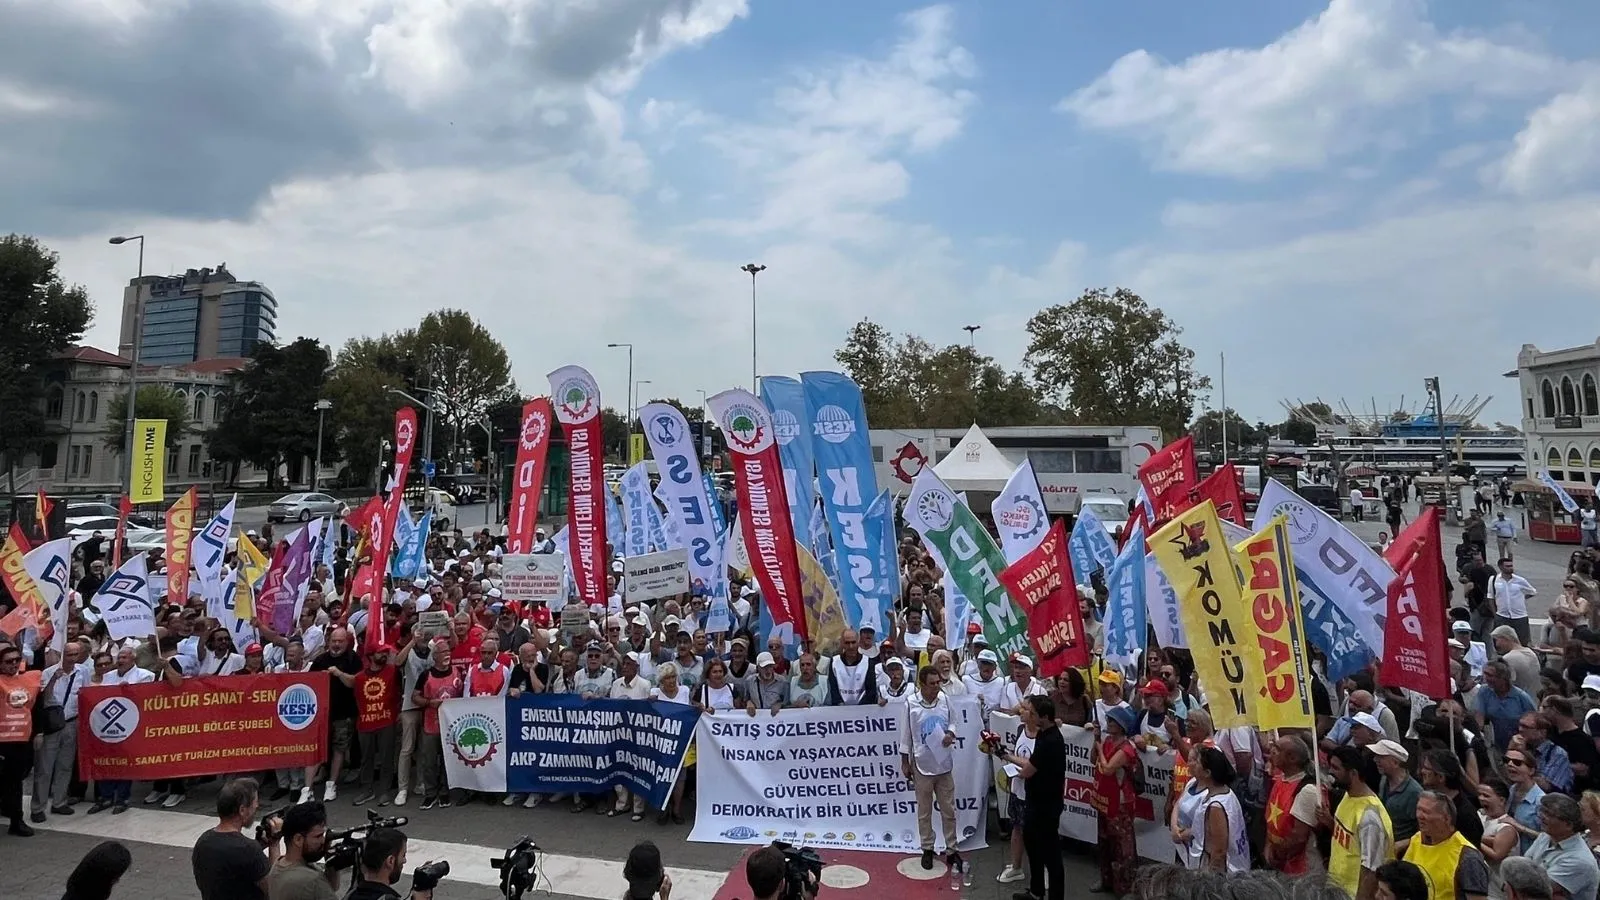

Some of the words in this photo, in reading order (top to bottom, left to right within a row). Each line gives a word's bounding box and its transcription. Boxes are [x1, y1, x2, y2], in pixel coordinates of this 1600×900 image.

[145, 427, 156, 451] TIME
[142, 454, 153, 496] ENGLISH
[143, 693, 200, 712] KÜLTÜR
[202, 691, 244, 706] SANAT
[247, 689, 277, 704] -SEN
[278, 703, 316, 716] KESK
[366, 702, 384, 712] DEV
[145, 723, 201, 738] İSTANBUL
[203, 719, 237, 733] BÖLGE
[238, 717, 273, 733] ŞUBESİ
[521, 706, 563, 724] EMEKLİ
[565, 710, 623, 728] MAAŞINA
[626, 710, 682, 736] YAPILAN
[711, 722, 760, 740] SATIŞ
[766, 716, 896, 739] SÖZLEŞMESİNE
[521, 726, 569, 743] SADAKA
[572, 726, 633, 745] ZAMMINA
[635, 731, 678, 756] HAYIR!
[721, 746, 786, 762] İNSANCA
[789, 744, 878, 762] YAŞAYACAK
[883, 741, 901, 756] Bİ
[1065, 741, 1089, 760] alsız
[93, 757, 128, 766] KÜLTÜR
[135, 755, 168, 766] SANAT
[170, 753, 182, 762] VE
[184, 748, 220, 761] TURİZM
[221, 745, 272, 758] EMEKÇİLERİ
[273, 743, 318, 755] SENDİKASI
[510, 752, 536, 766] AKP
[538, 752, 593, 769] ZAMMINI
[595, 754, 613, 770] AL
[615, 750, 656, 777] BAŞINA
[788, 762, 875, 780] GÜVENCELİ
[879, 762, 899, 780] İŞ,
[763, 781, 850, 799] GÜVENCELİ
[855, 780, 915, 795] GELECE
[711, 803, 812, 819] DEMOKRATİK
[816, 802, 842, 818] BİR
[847, 801, 889, 817] ÜLKE
[893, 797, 978, 814] İSTOUZ
